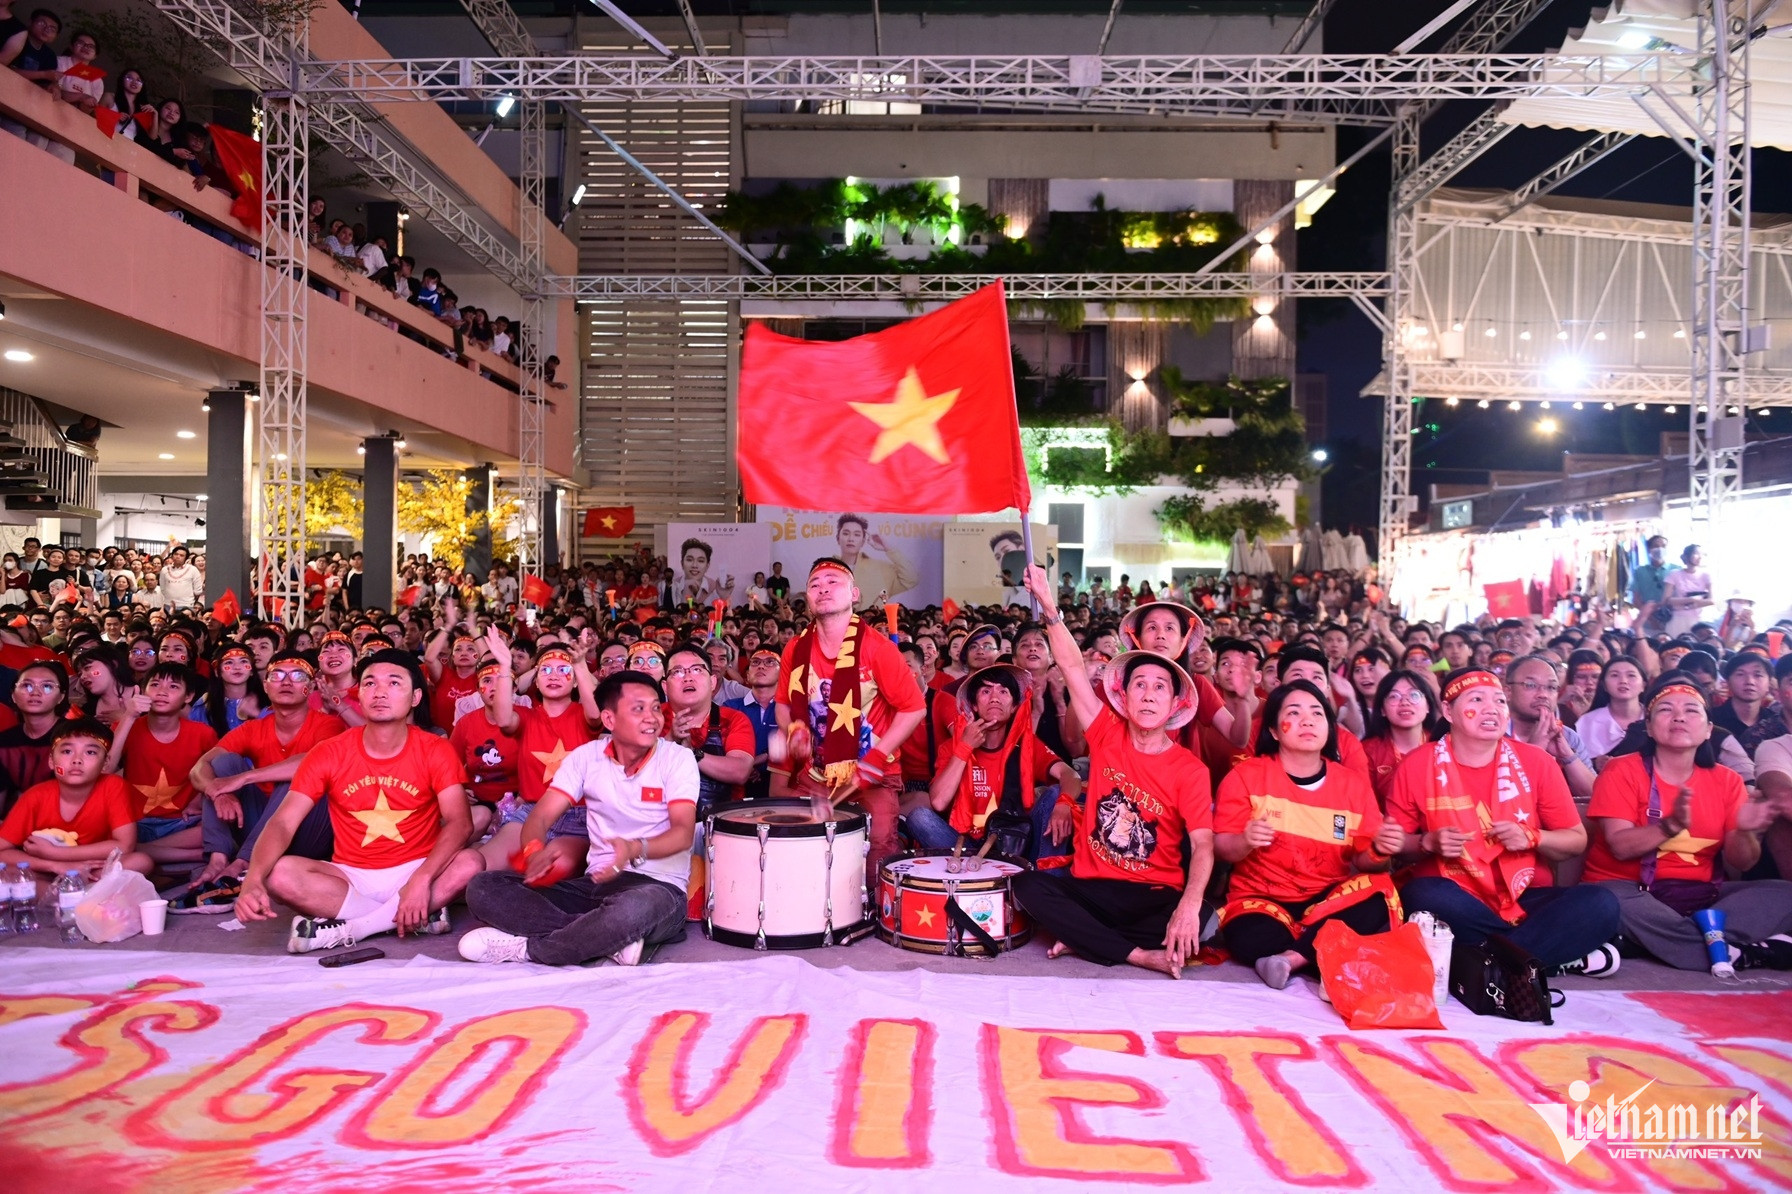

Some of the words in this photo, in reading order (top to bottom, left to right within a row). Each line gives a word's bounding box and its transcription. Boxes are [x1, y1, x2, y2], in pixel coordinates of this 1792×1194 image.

[1461, 676, 1479, 687] NAM
[343, 782, 359, 797] TÔI
[358, 774, 376, 787] YÊU
[377, 775, 399, 788] VIỆT
[399, 780, 420, 797] NAM
[1266, 808, 1282, 819] VIE
[116, 1001, 589, 1153] GO
